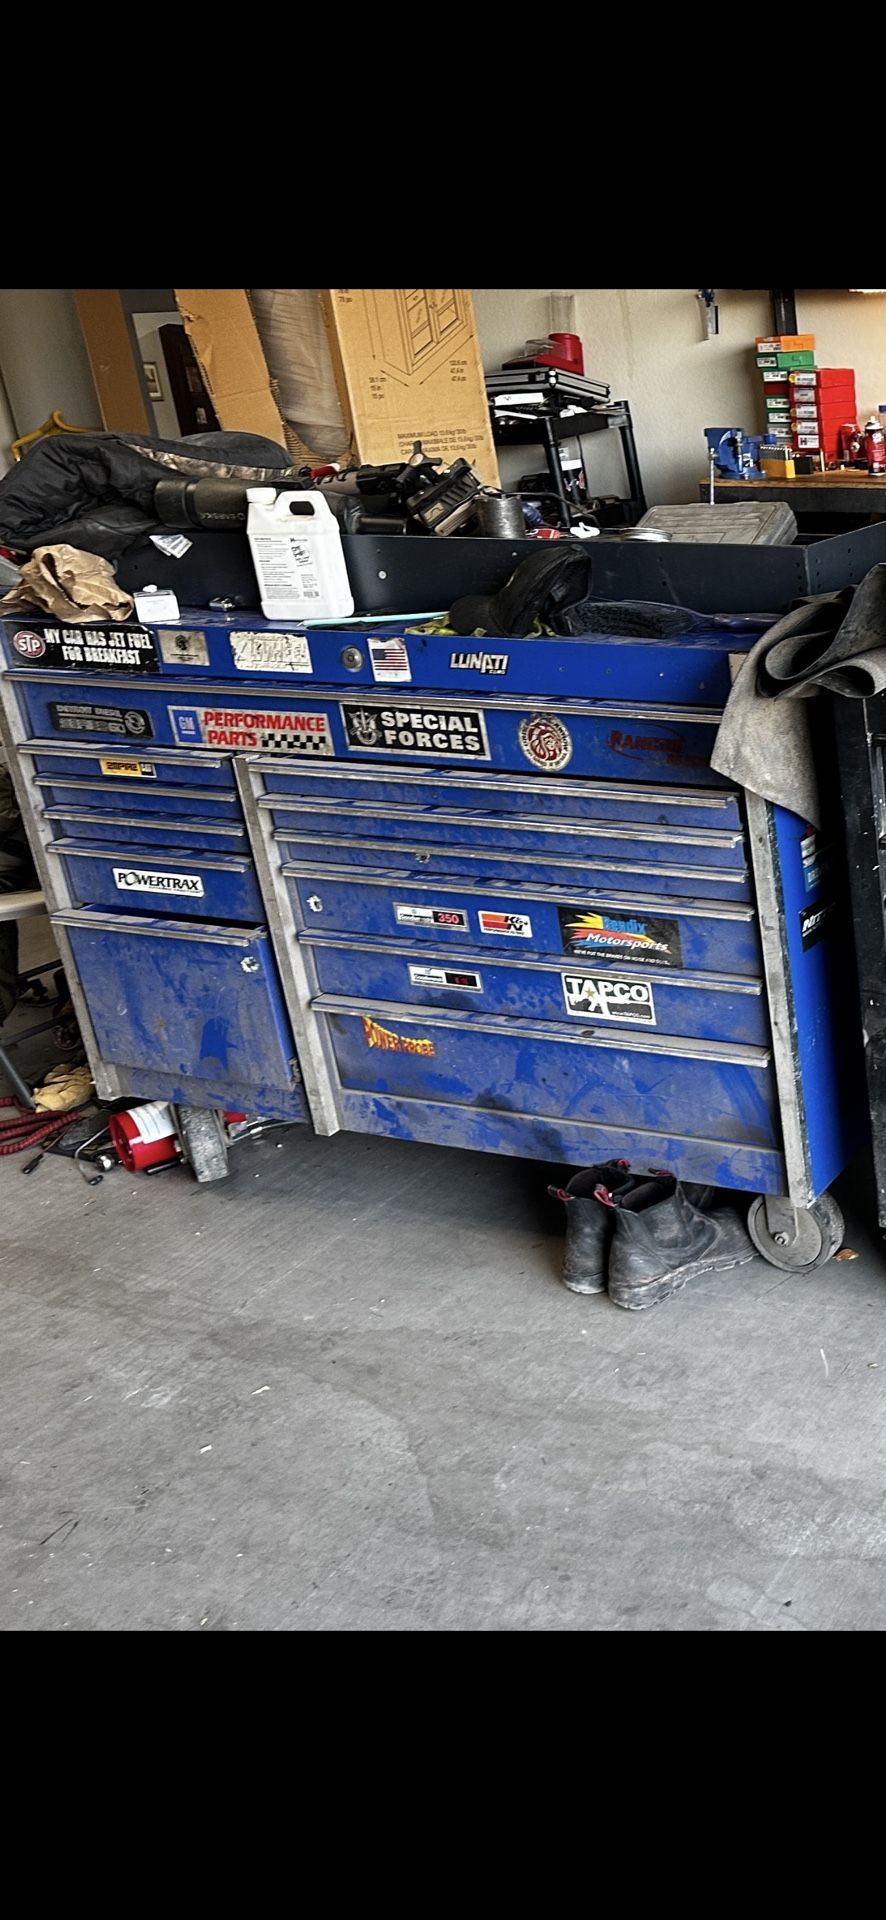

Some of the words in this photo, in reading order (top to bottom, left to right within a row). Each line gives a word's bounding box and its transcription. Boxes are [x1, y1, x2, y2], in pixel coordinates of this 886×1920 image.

[18, 634, 41, 653] STP
[43, 628, 61, 644] MY
[62, 629, 84, 645] CAR
[84, 630, 107, 647] HAS
[108, 631, 126, 648] JET
[127, 632, 153, 649] FUEL
[61, 645, 84, 662] FOR
[84, 647, 141, 665] BREAKFAST
[450, 652, 509, 673] LUNATI
[178, 716, 195, 730] GM
[204, 711, 326, 732] PERFORMANCE
[380, 711, 478, 733] SPECIAL
[207, 730, 257, 747] PARTS
[384, 730, 481, 751] FORCES
[118, 872, 199, 891] POWERTRAX
[437, 912, 460, 924] 350
[586, 933, 669, 951] Motorsports
[565, 977, 649, 1002] TAPCO
